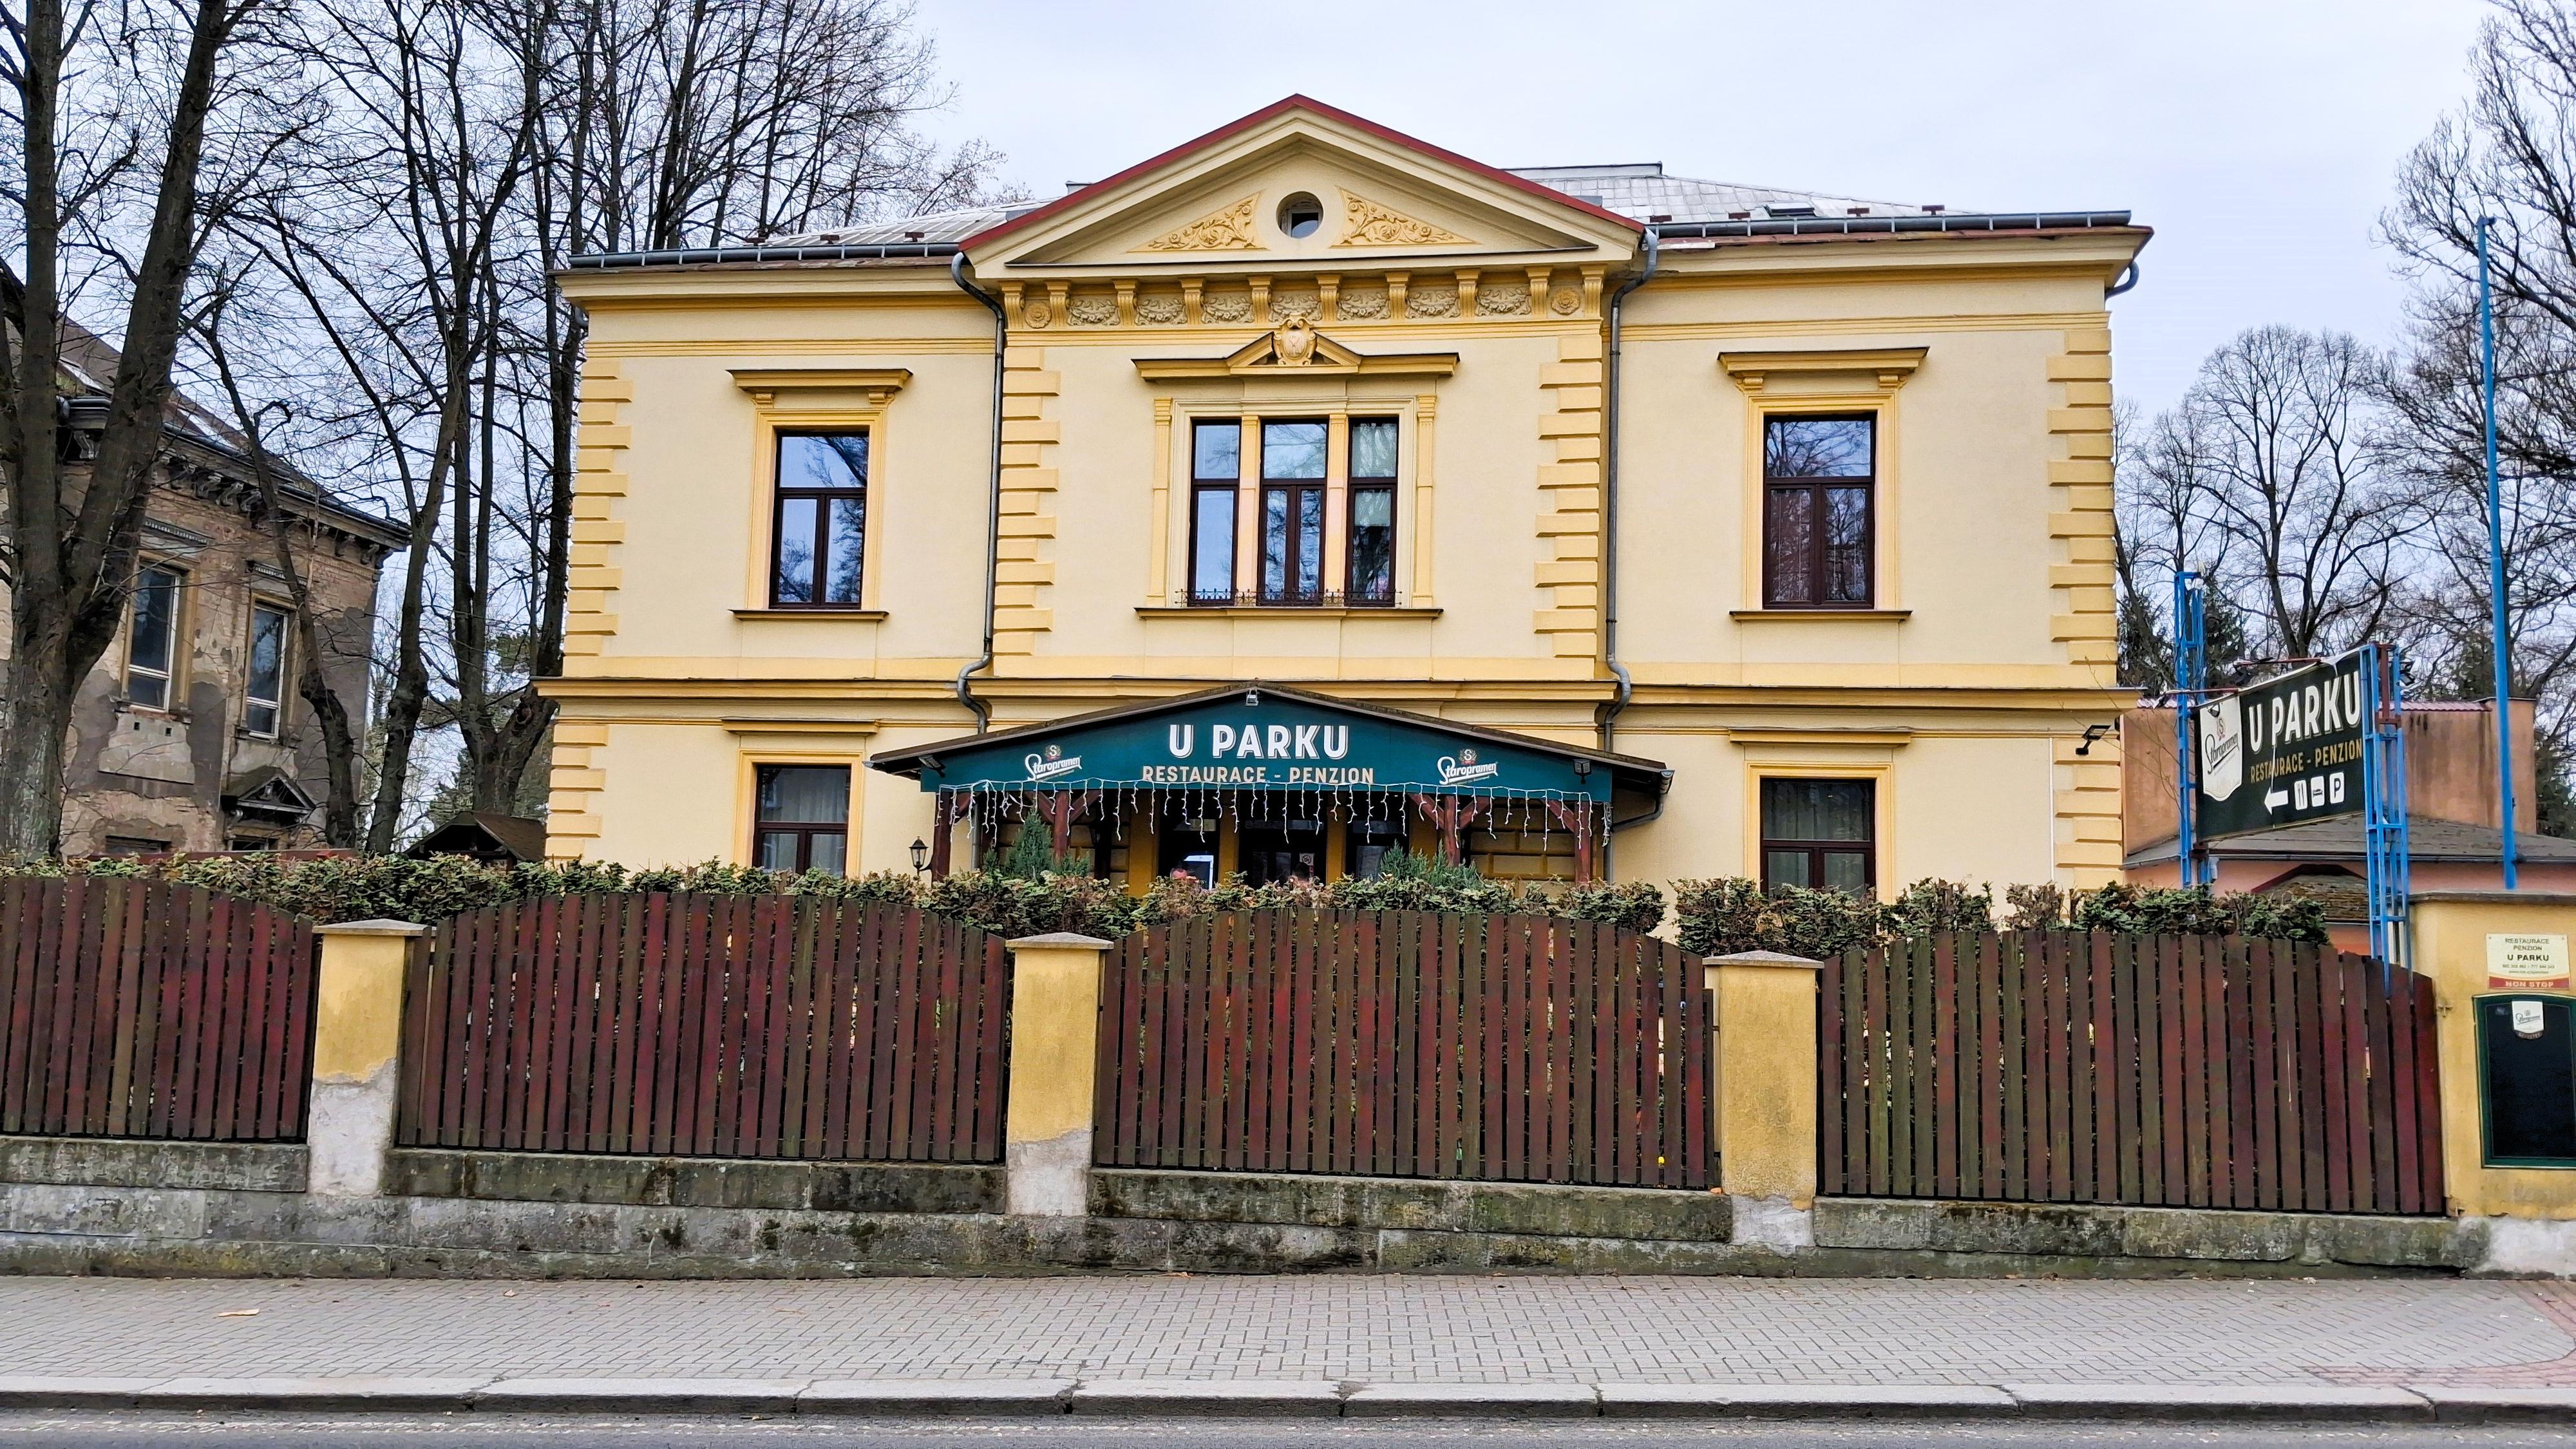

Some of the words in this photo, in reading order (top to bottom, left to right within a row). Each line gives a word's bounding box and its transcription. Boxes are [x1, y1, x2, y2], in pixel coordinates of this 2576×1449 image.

[2248, 703, 2263, 754] U
[2271, 670, 2362, 749] PARKU
[1170, 724, 1194, 759] U
[1213, 724, 1349, 759] PARKU
[1025, 753, 1082, 781] Staropramen
[1142, 766, 1267, 782] RESTAURACE
[1290, 767, 1374, 783] PENZION
[1437, 756, 1498, 785] Staropramen
[2250, 752, 2305, 783] RESTAURACE
[2315, 738, 2362, 768] PENZION
